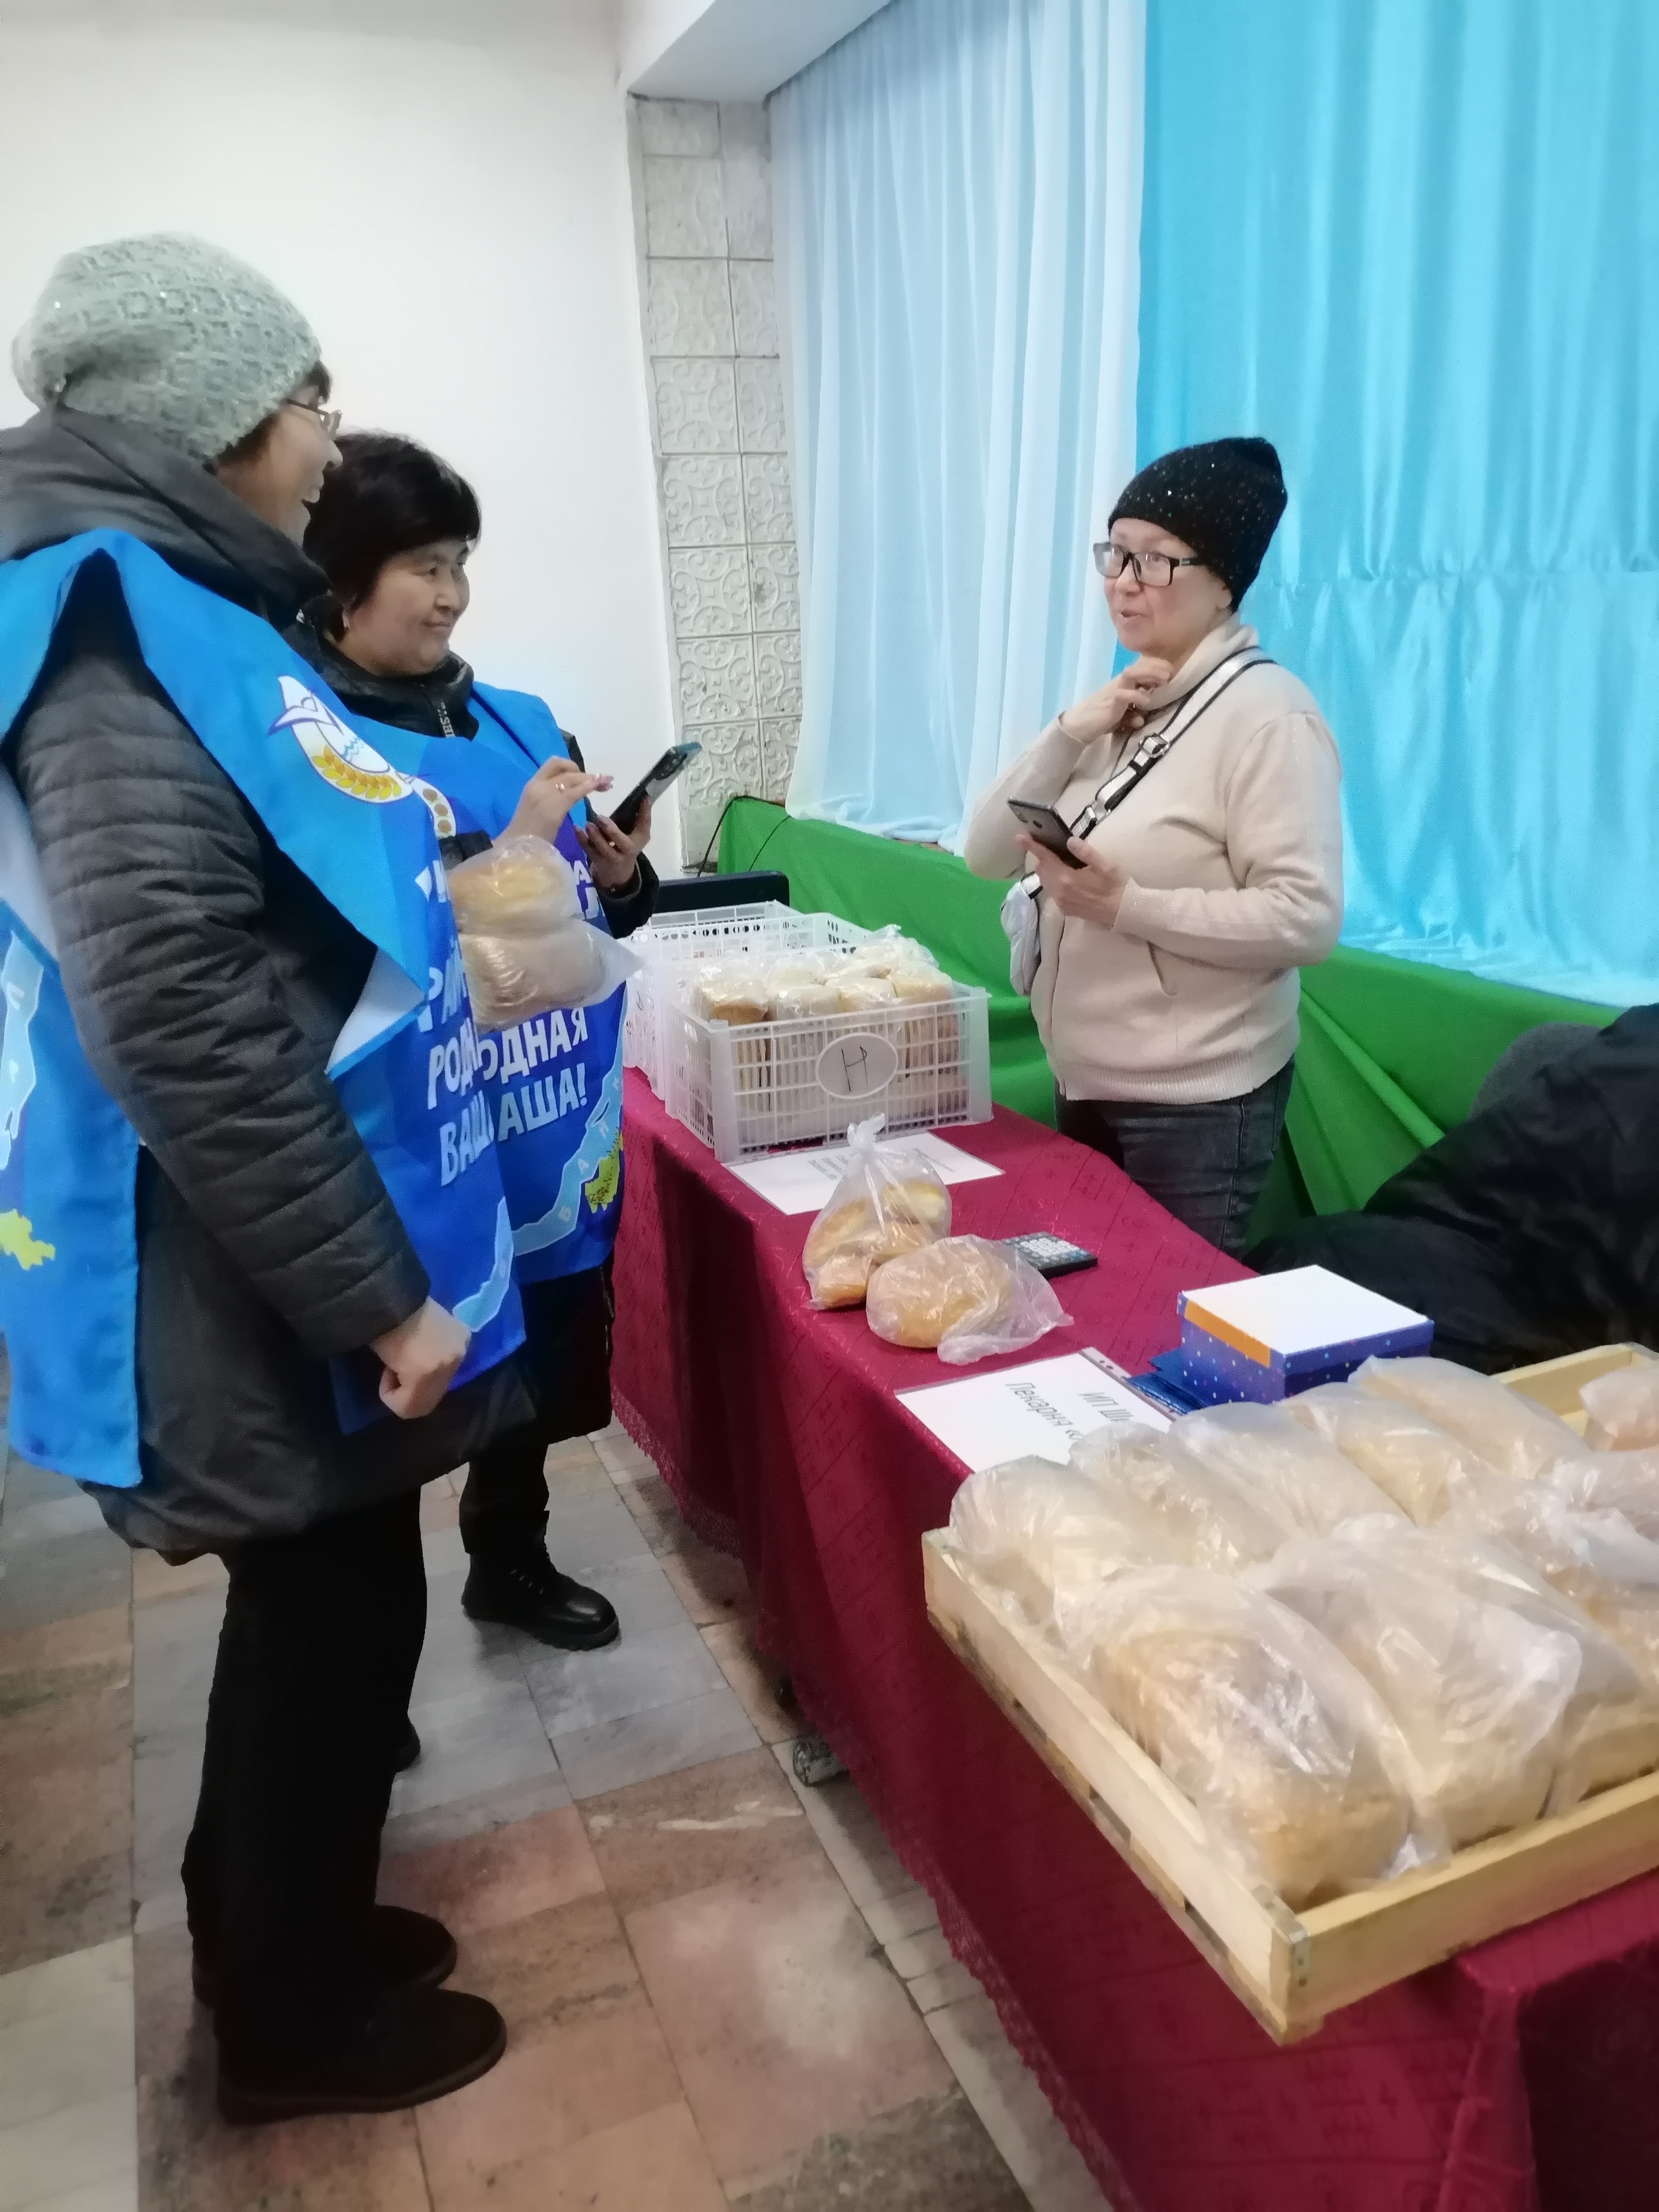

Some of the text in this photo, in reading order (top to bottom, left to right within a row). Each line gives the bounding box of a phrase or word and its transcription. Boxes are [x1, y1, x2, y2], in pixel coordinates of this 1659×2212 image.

[478, 1007, 589, 1084] ОДНАЯ
[439, 1089, 495, 1186] ВАШ
[498, 1062, 588, 1142] АША!
[1004, 1382, 1074, 1426] Пекарня
[1077, 1392, 1119, 1407] ИП
